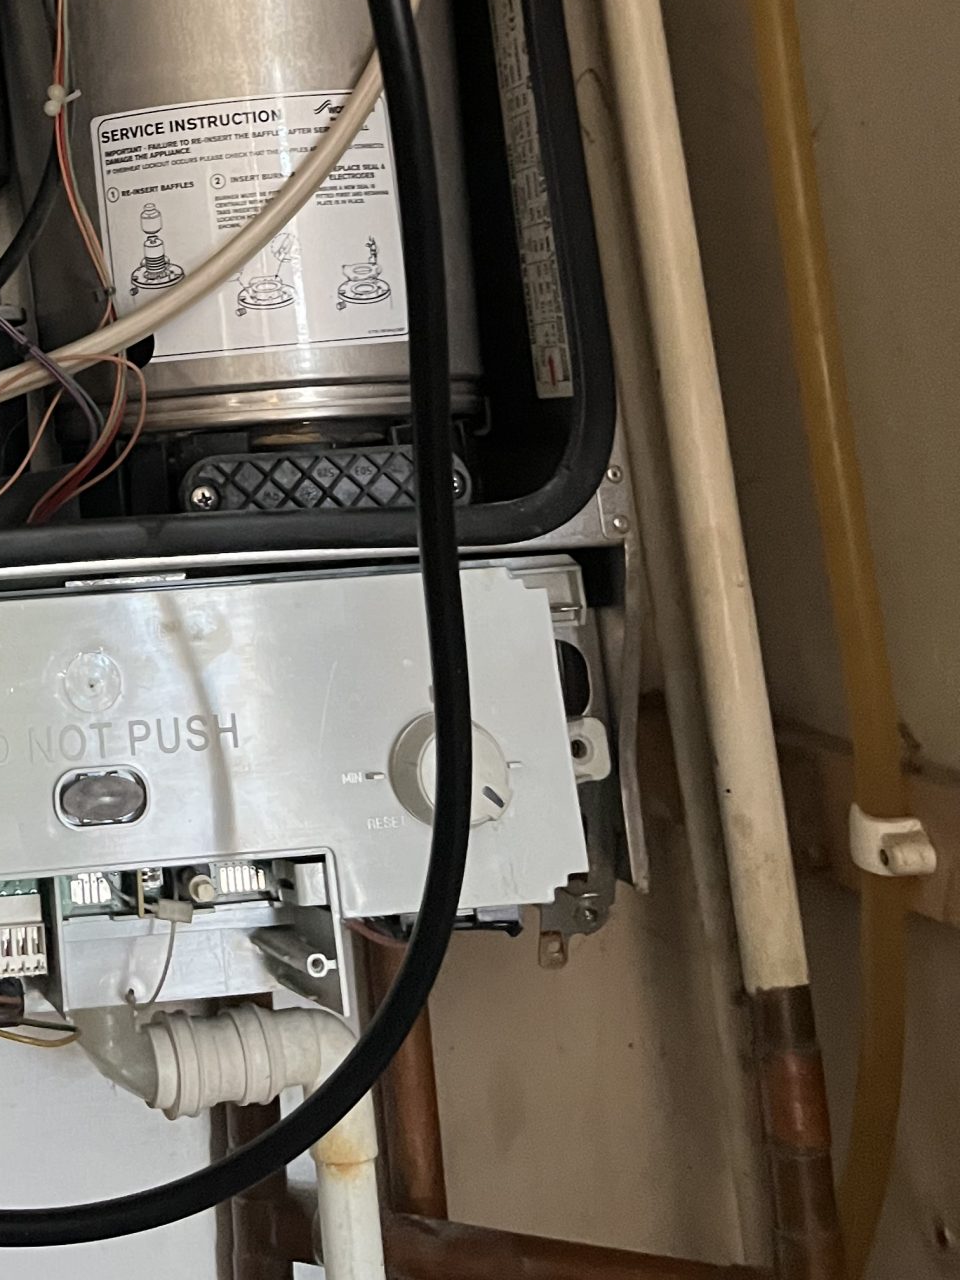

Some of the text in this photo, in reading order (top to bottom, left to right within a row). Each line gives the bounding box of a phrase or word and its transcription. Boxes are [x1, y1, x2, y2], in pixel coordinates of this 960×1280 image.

[101, 109, 282, 144] SERVICE INSTRUCTION
[104, 145, 142, 158] IMPORTANT
[147, 140, 178, 151] FAILURE
[191, 134, 232, 145] RE-INSERT
[234, 132, 249, 140] THE
[287, 127, 312, 135] AFTER
[105, 156, 133, 166] DAMAGE
[149, 147, 191, 159] APPLIANCE
[171, 157, 198, 166] OCCURS
[199, 154, 224, 162] PLEASE
[225, 152, 247, 160] CHECK
[214, 177, 221, 185] 2
[230, 174, 260, 183] INSERT
[121, 181, 195, 197] RE-INSERT BAFFLES
[28, 721, 113, 763] NOT
[127, 712, 240, 756] PUSH
[341, 772, 363, 785] MIN
[367, 815, 405, 830] RESET
